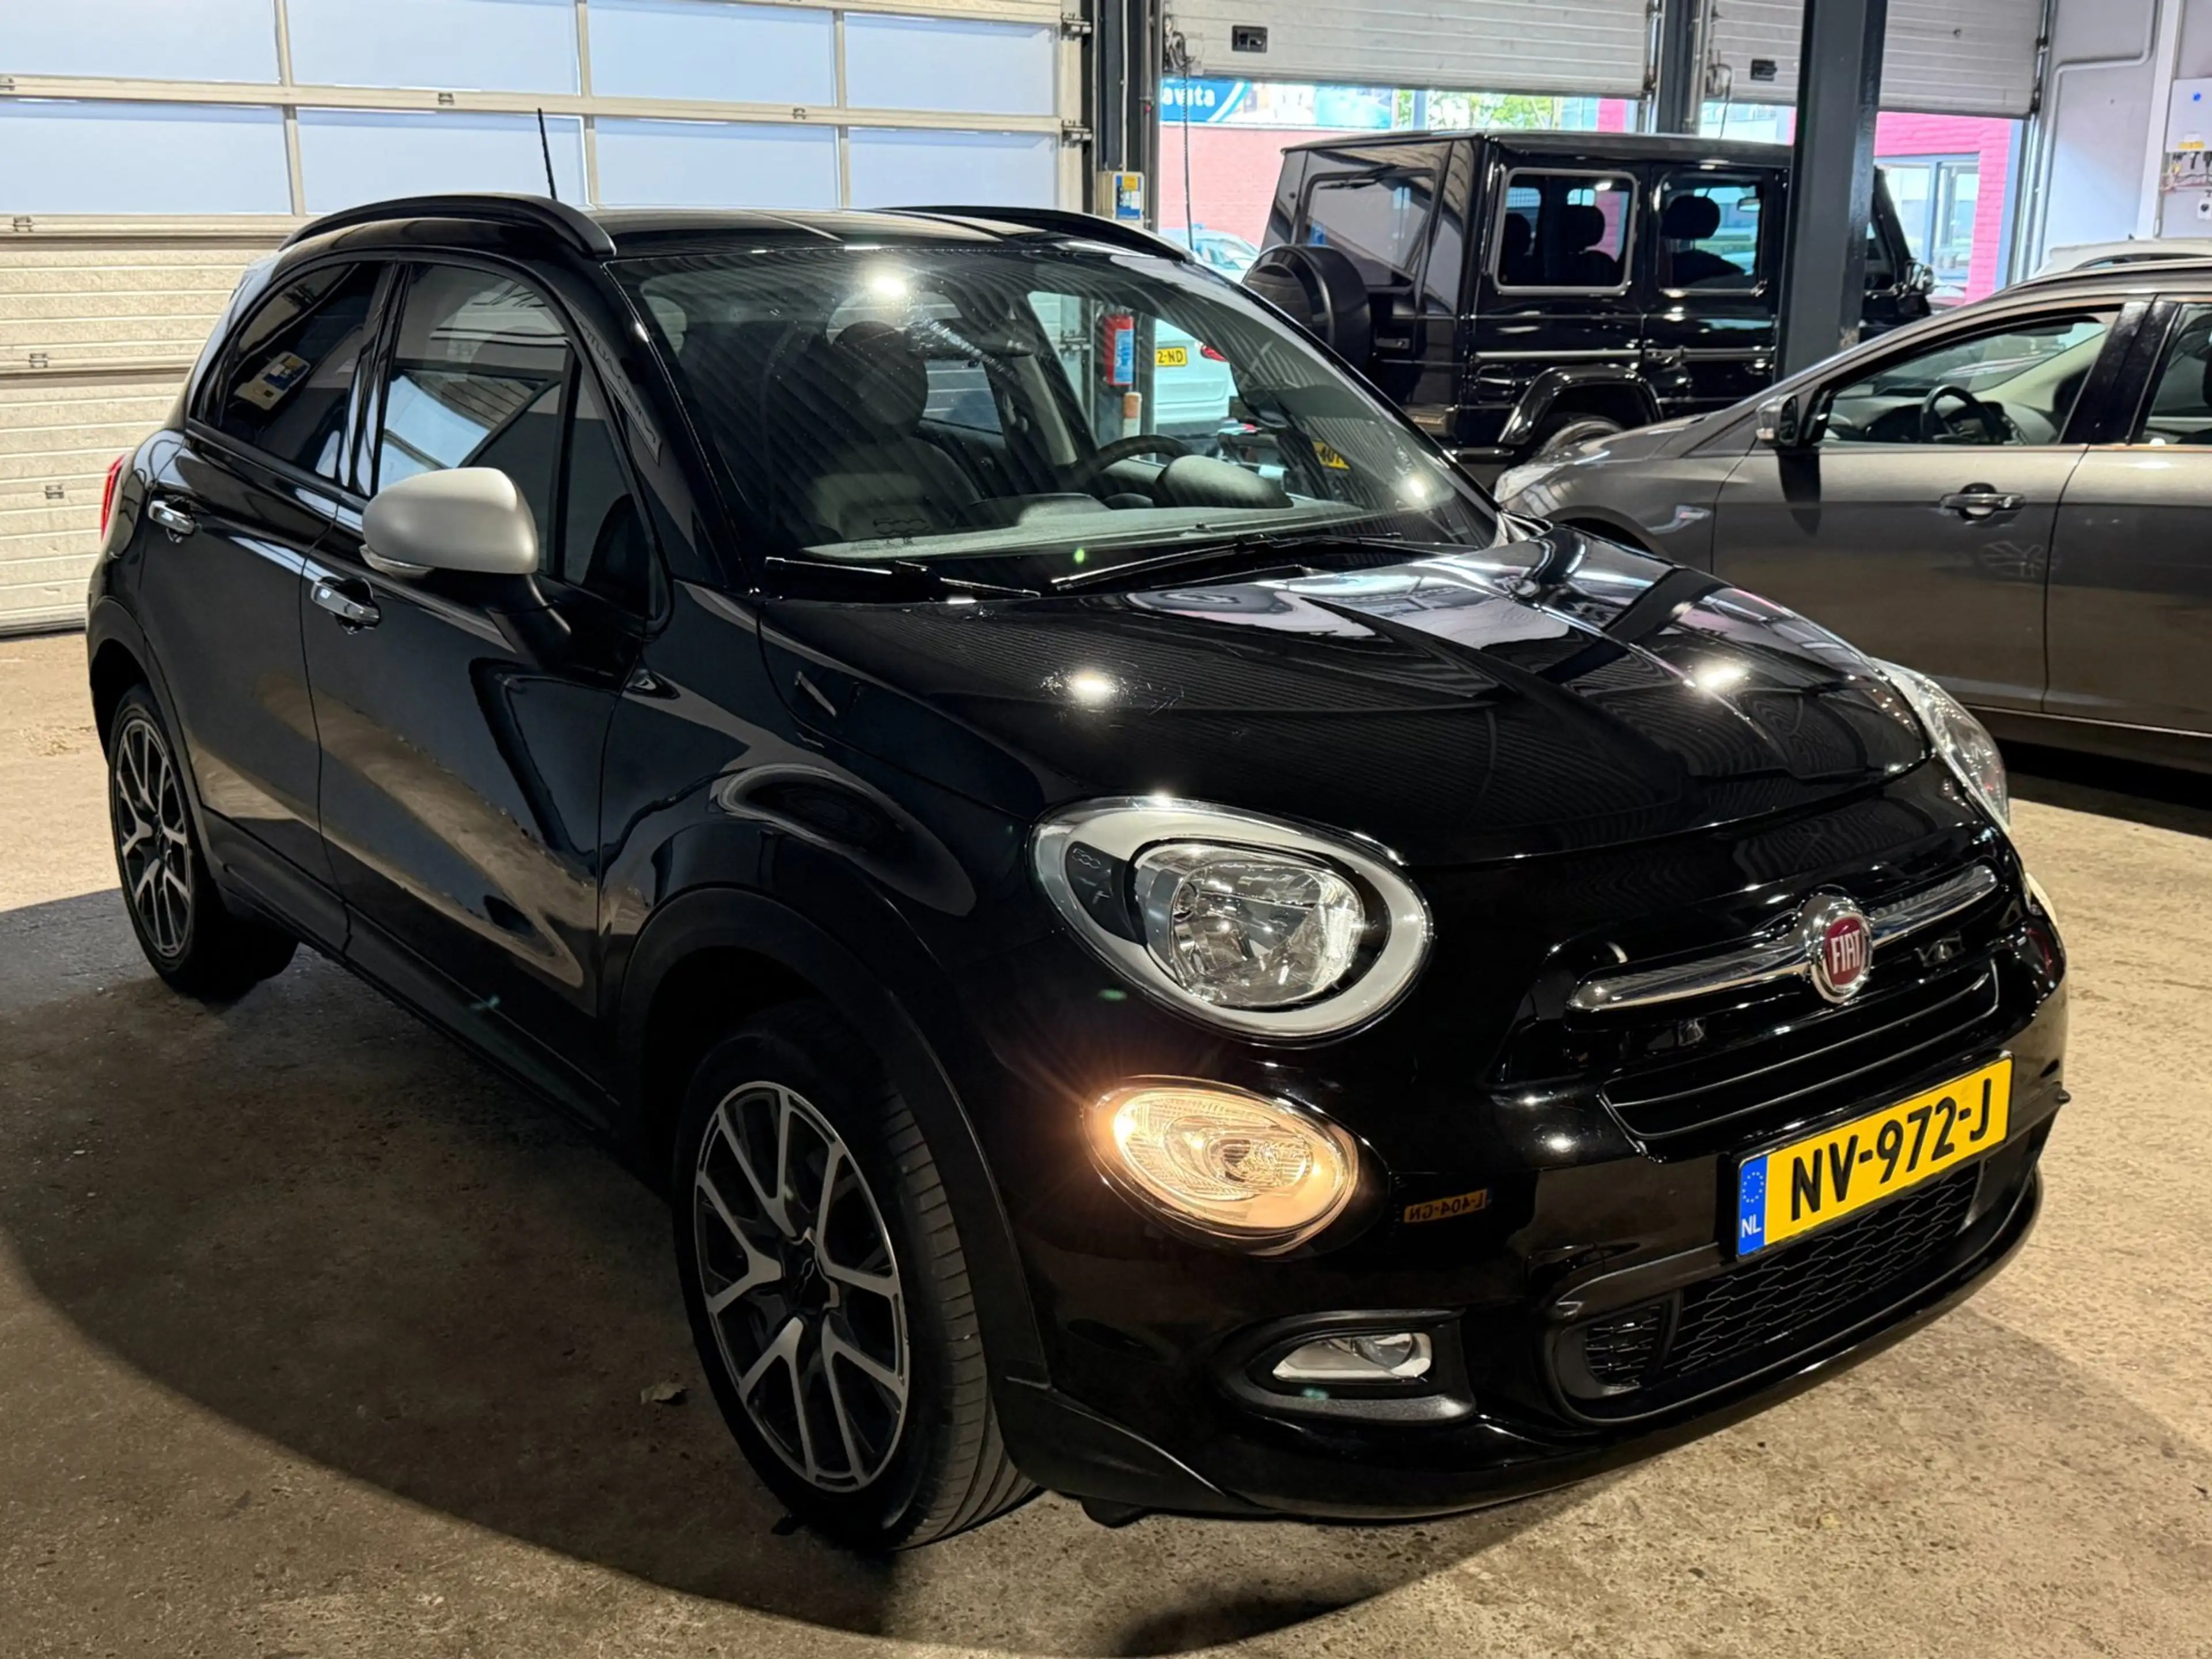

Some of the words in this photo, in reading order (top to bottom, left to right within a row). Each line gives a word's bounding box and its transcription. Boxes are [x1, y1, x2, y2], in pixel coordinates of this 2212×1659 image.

[1831, 930, 1861, 974] FIAT
[1791, 1078, 1992, 1222] NV-972-J
[1741, 1214, 1762, 1238] NL
